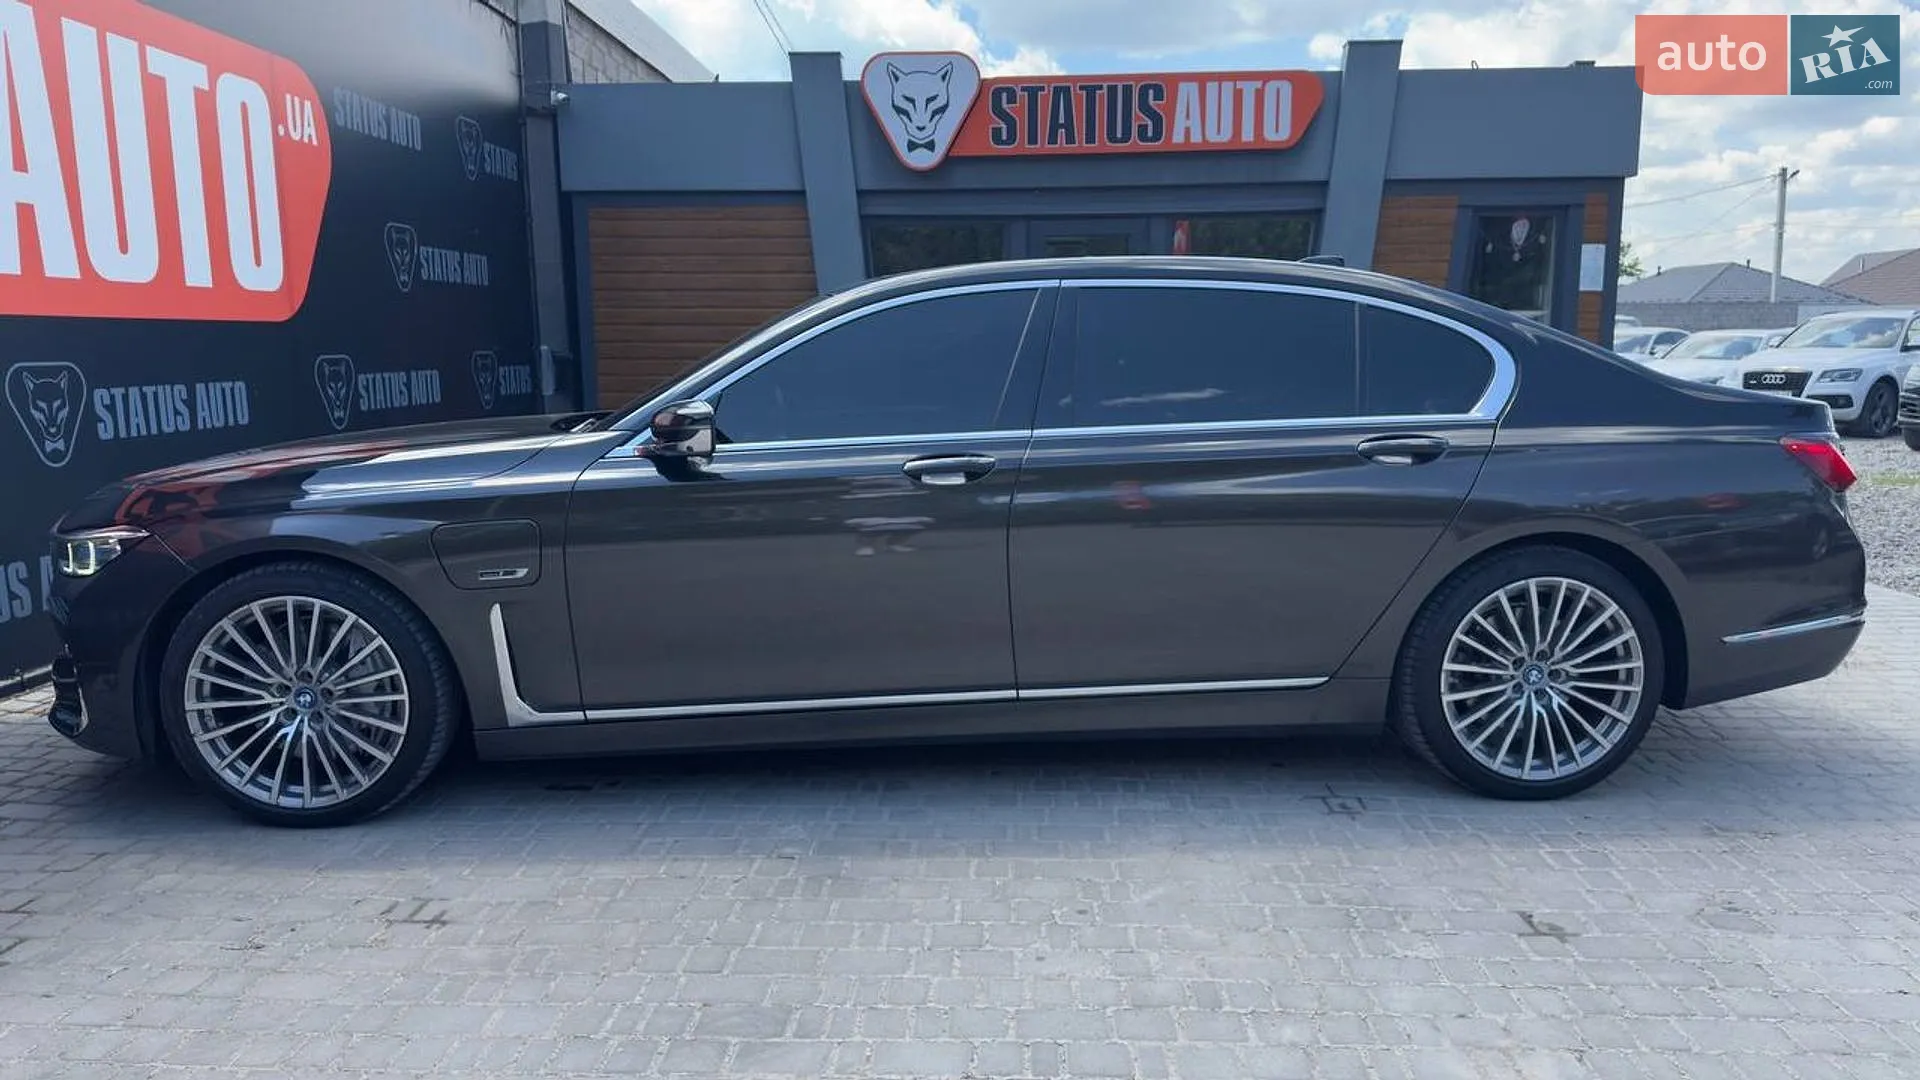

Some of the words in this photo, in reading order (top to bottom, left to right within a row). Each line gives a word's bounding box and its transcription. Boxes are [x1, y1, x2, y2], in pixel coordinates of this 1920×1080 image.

[333, 87, 387, 140] STATUS
[390, 107, 421, 151] AUTO
[989, 82, 1166, 148] STATUS
[1172, 80, 1292, 144] AUTO
[0, 0, 284, 292] AUTO
[483, 141, 518, 182] STATUS
[420, 246, 461, 283] STATUS
[463, 252, 489, 286] AUTO
[358, 371, 408, 411] STATUS
[410, 369, 441, 406] AUTO
[499, 365, 532, 396] STATUS
[93, 384, 190, 440] STATUS
[195, 381, 249, 429] AUTO
